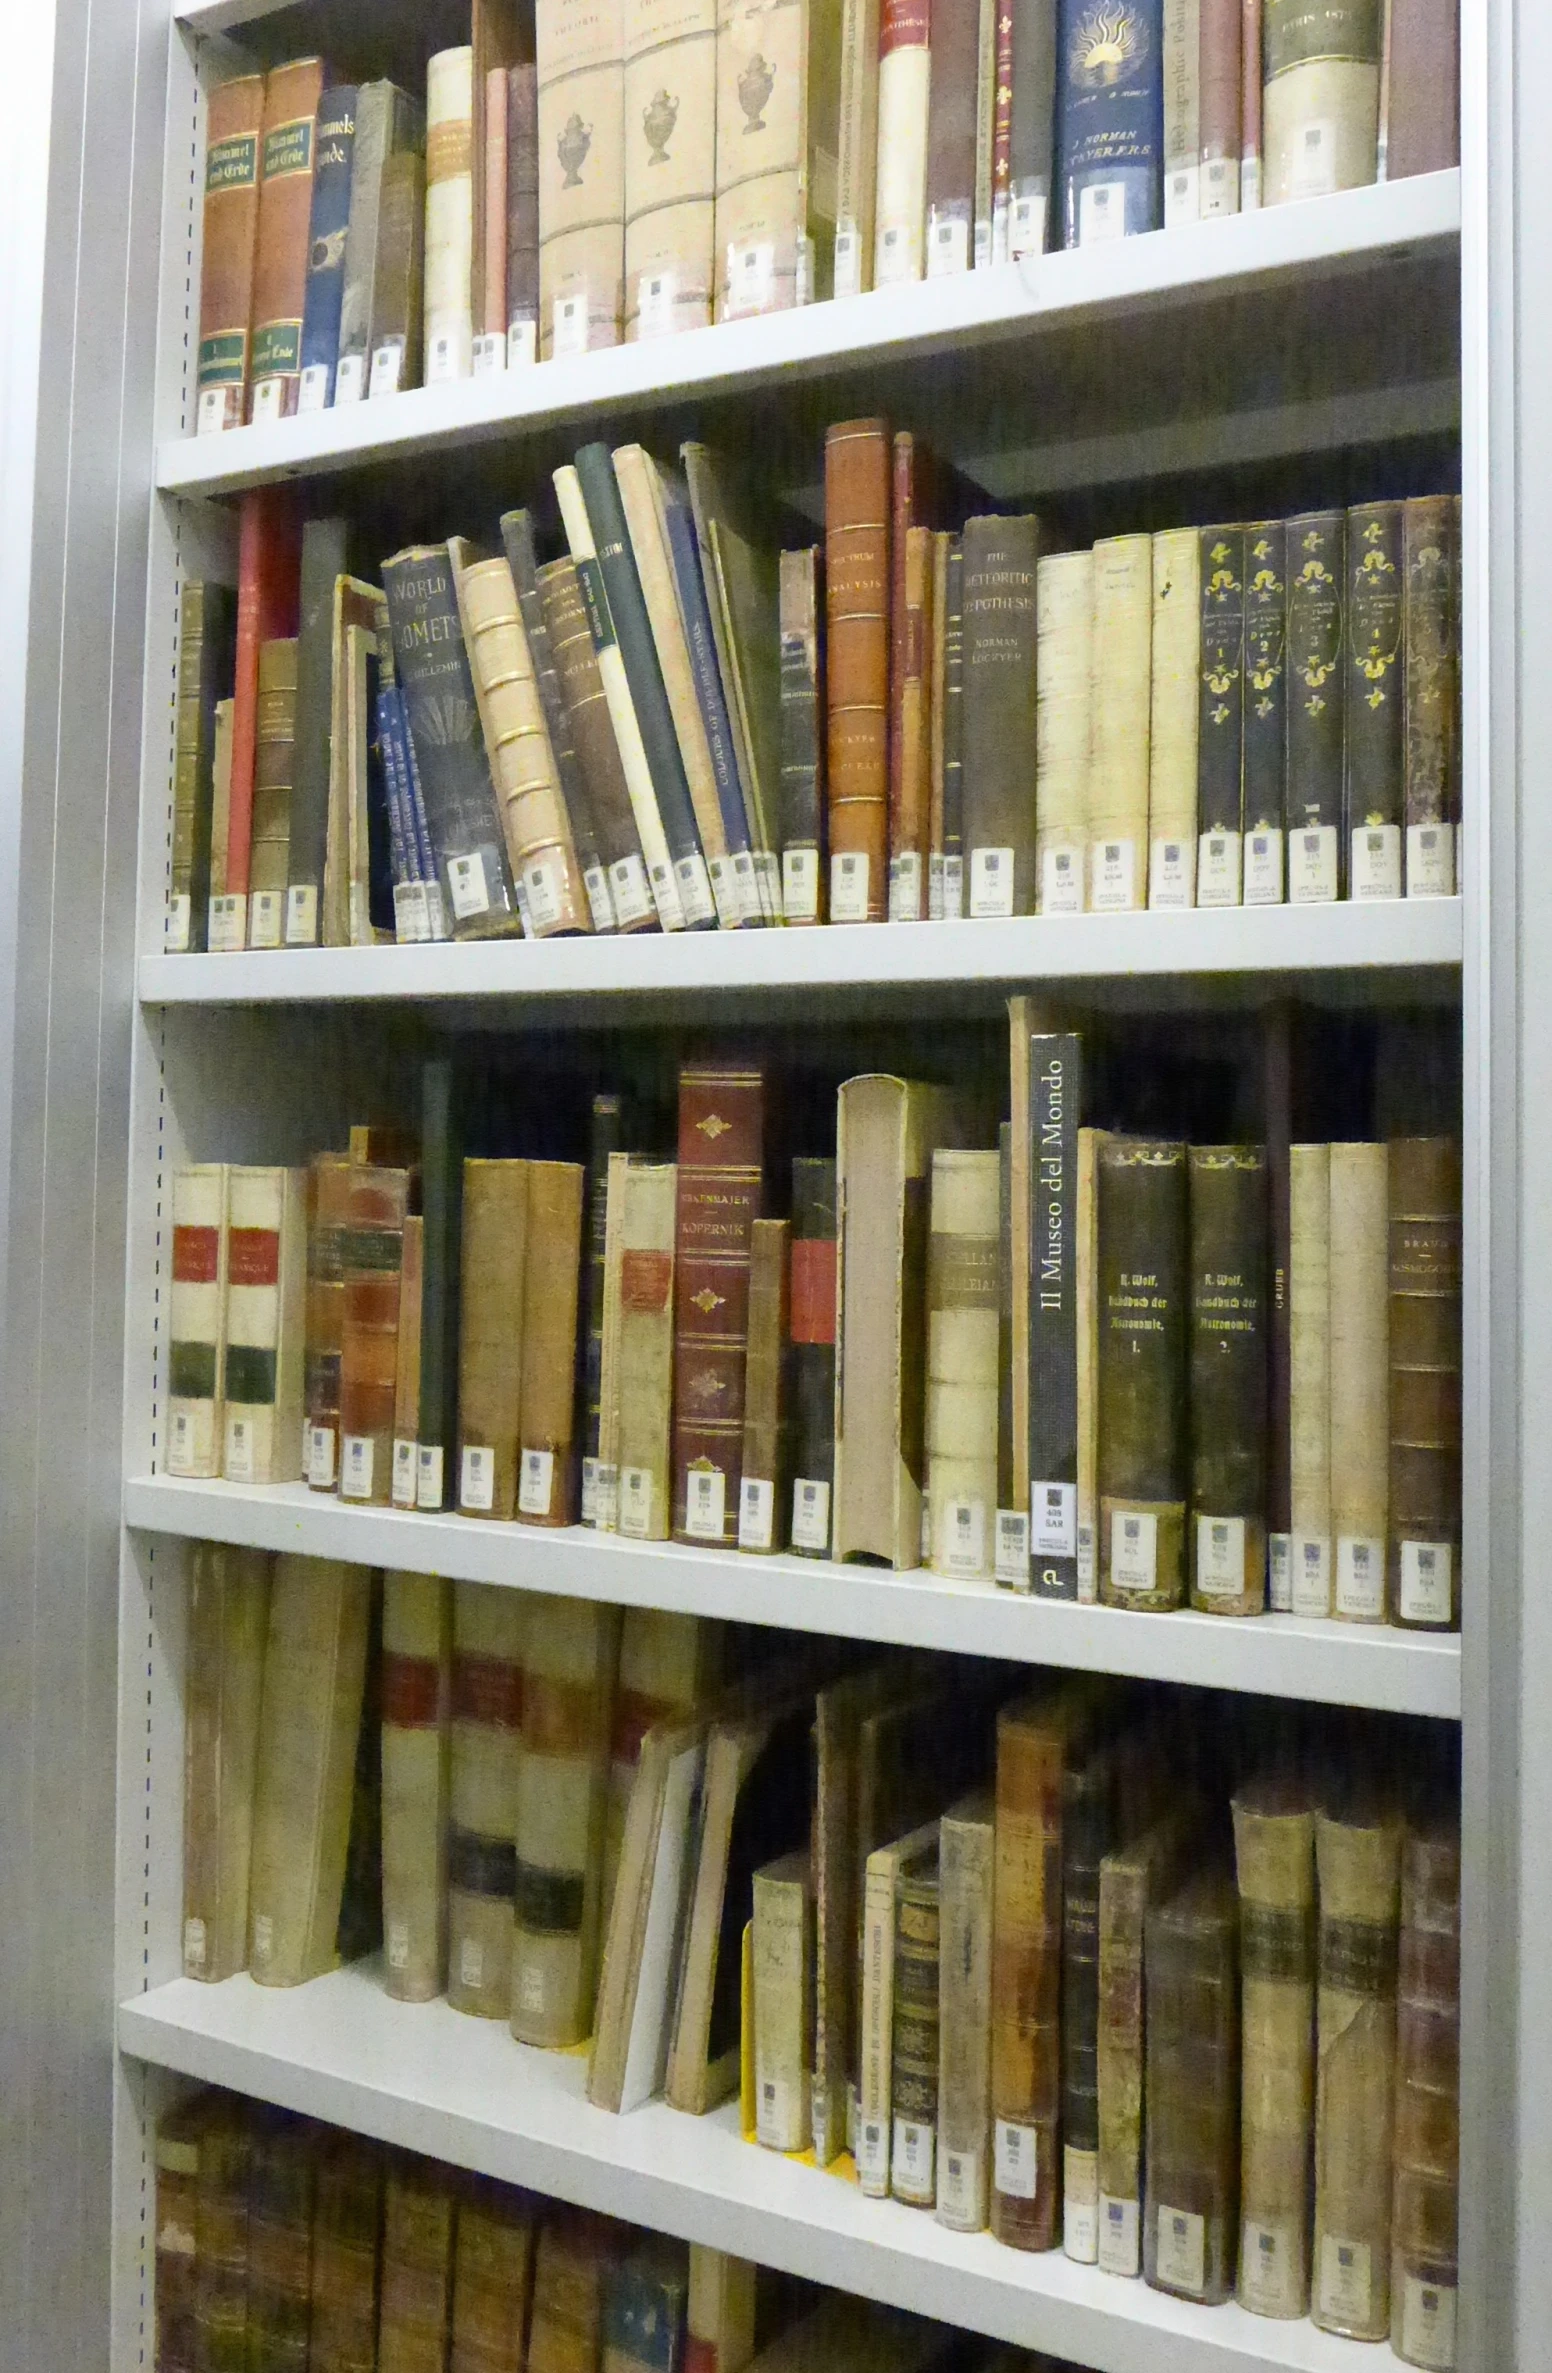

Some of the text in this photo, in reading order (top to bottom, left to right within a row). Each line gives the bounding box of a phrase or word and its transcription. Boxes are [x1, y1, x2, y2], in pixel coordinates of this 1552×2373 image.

[1084, 130, 1137, 146] NORMAN
[393, 577, 447, 602] WORLD
[975, 637, 1018, 648] NORMAN
[1260, 640, 1269, 652] 2
[1041, 1060, 1062, 1310] Il Museo del Mondo
[1151, 1296, 1167, 1309] der
[1045, 1519, 1064, 1528] SAR
